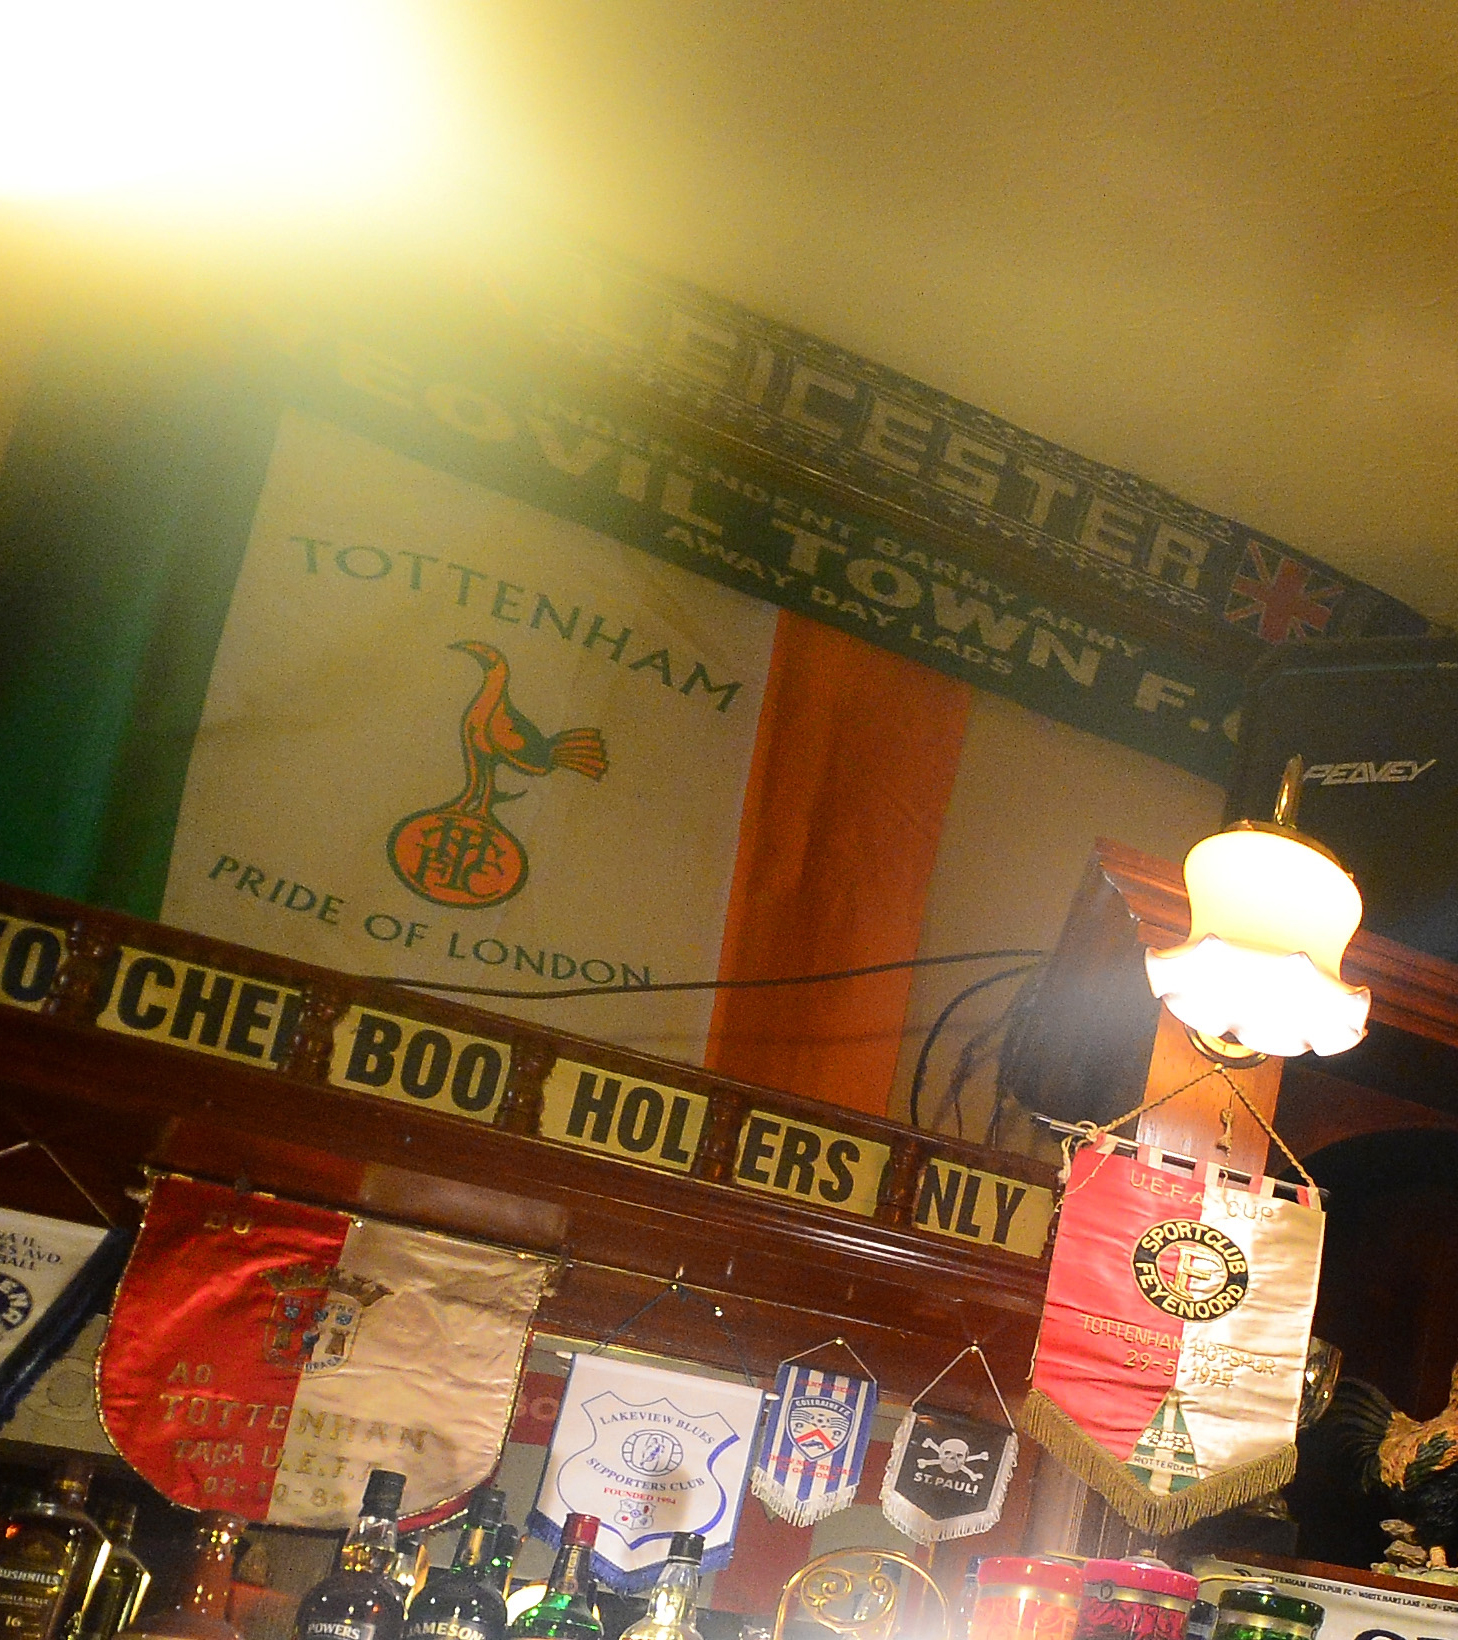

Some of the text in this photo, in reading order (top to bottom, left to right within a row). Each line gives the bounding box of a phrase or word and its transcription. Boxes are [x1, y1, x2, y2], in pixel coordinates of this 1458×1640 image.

[655, 308, 1211, 590] EICESTER
[338, 335, 1102, 690] EOVIL TOWN
[290, 535, 743, 714] TOTTENHAM
[662, 526, 1014, 676] AWAY DAY LADS
[878, 533, 1018, 608] BARMY
[1027, 606, 1147, 659] ARMY
[1303, 759, 1437, 787] PEAVEY
[208, 854, 657, 988] PRIDE OF LONDON
[1226, 1199, 1275, 1221] CUP
[1140, 1220, 1246, 1275] SPORTCLUB
[1134, 1261, 1245, 1321] FEYENOORD
[1079, 1313, 1277, 1376] TOTTENHAM HOTSPUR
[599, 1410, 716, 1446] LAKEVIEW BLUES
[584, 1457, 706, 1493] SUPPORTERS CLUB
[602, 1486, 650, 1503] FOUNDED
[0, 1567, 60, 1588] USHMILLS
[306, 1622, 361, 1640] POWERS
